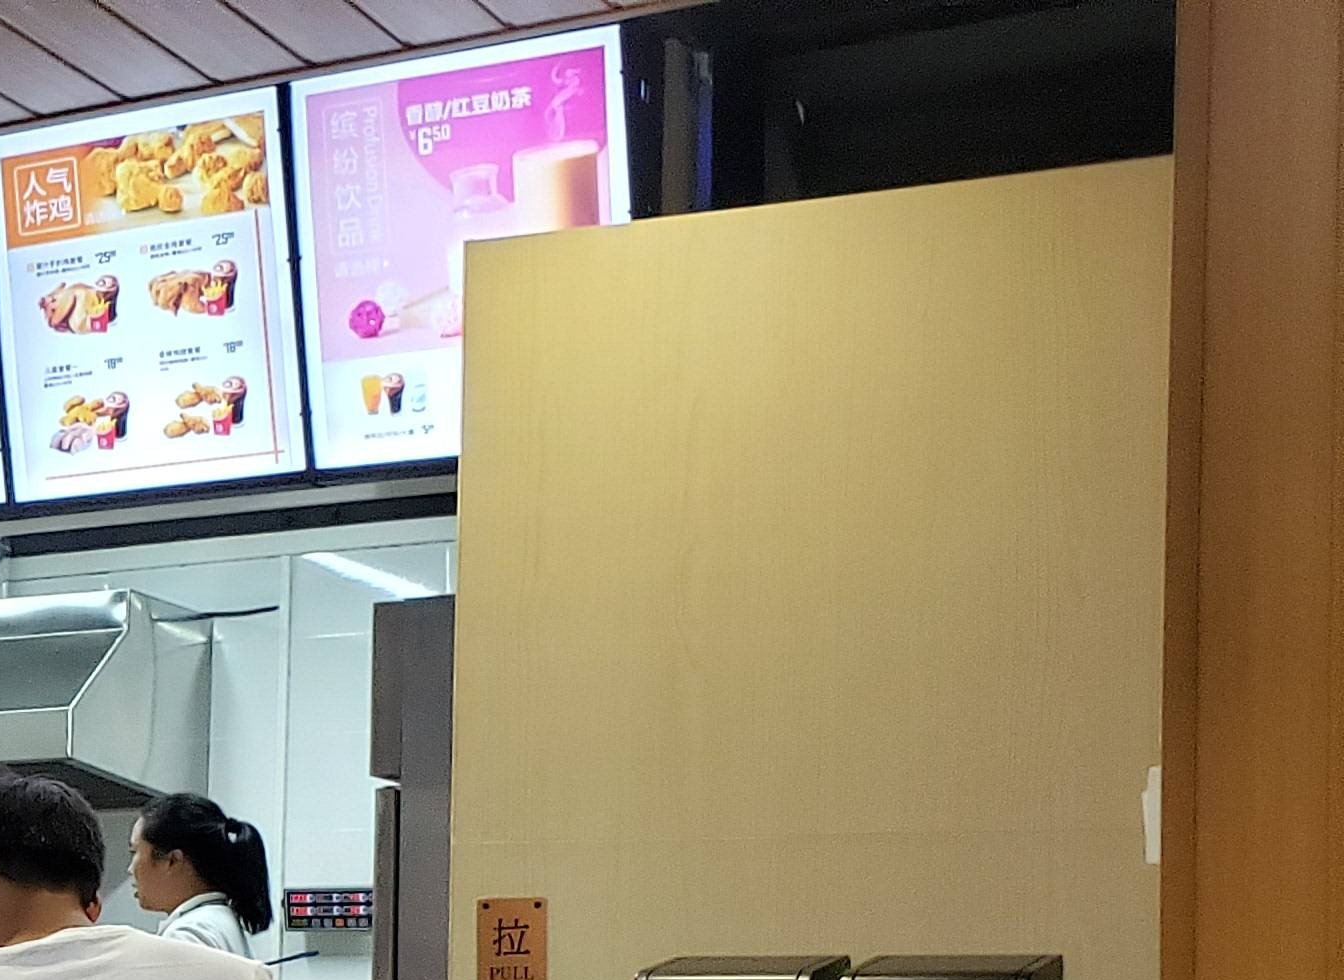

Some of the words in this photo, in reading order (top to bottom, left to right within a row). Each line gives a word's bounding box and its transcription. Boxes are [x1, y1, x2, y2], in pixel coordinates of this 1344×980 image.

[22, 167, 73, 200] 人气
[330, 110, 363, 249] 缤纷饮品
[23, 196, 74, 228] 炸鸡
[492, 918, 531, 957] 拉
[489, 966, 535, 980] PULL
